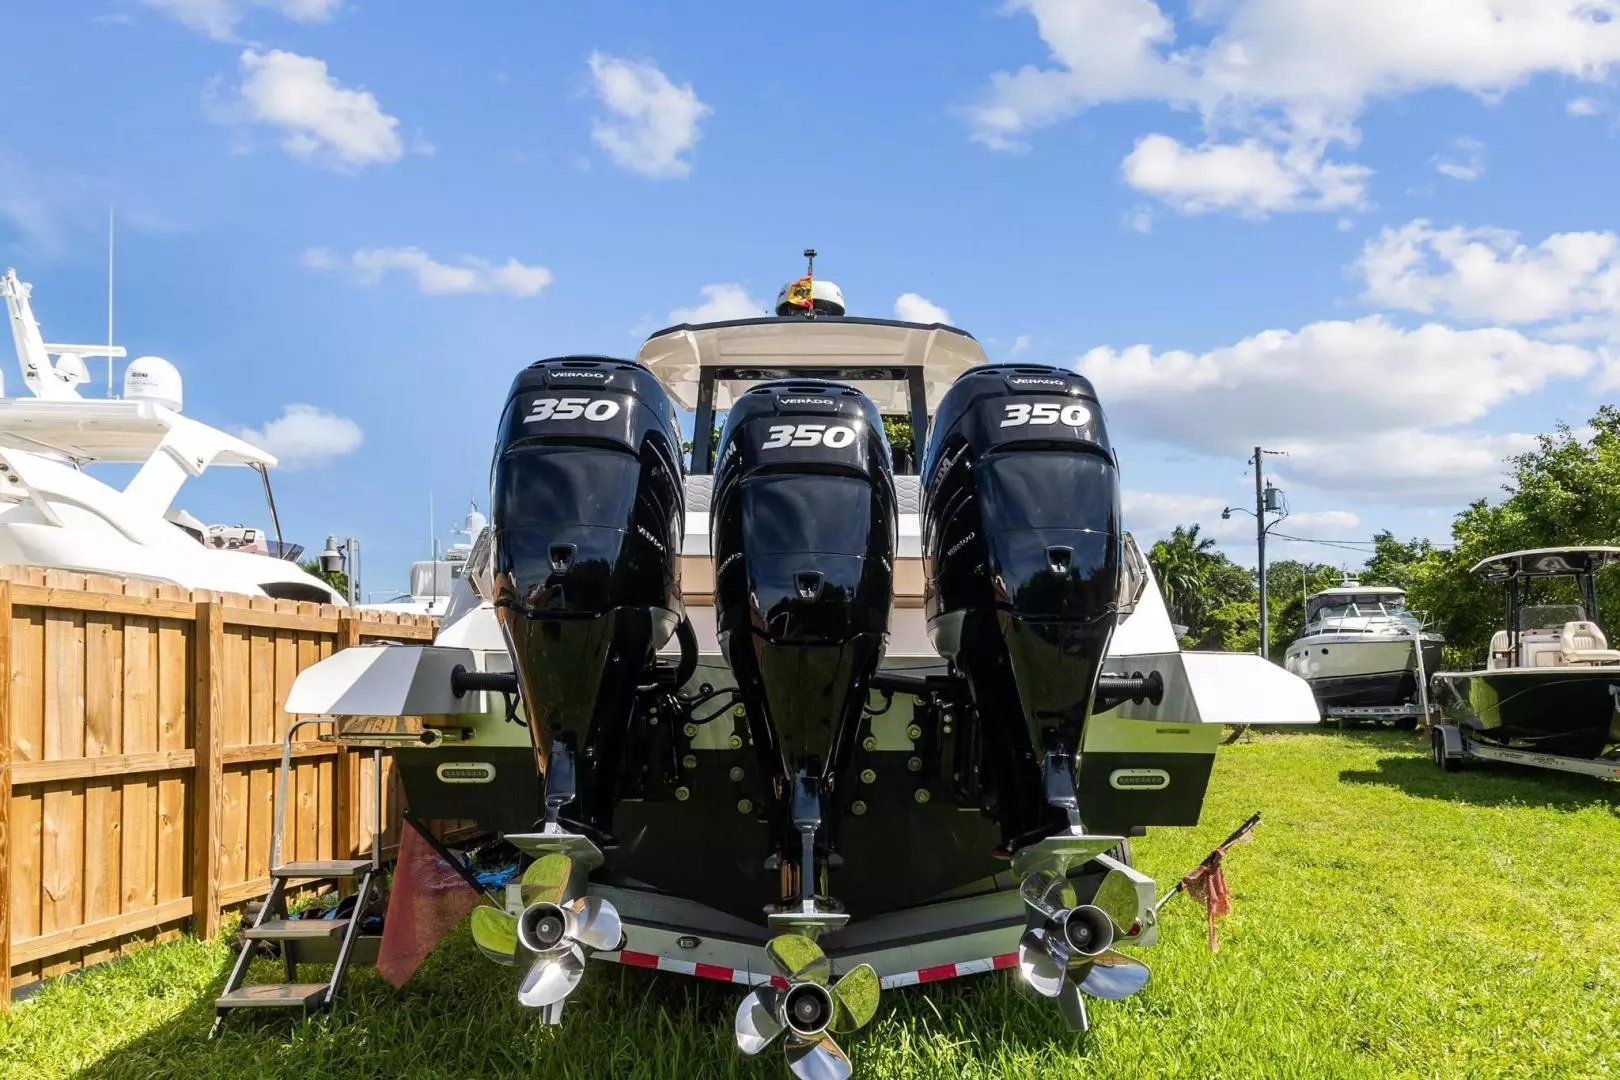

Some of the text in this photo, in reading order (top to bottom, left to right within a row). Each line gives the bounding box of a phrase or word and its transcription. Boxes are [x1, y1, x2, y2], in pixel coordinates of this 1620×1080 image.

[523, 397, 620, 424] 350
[1000, 403, 1091, 428] 350
[761, 424, 855, 450] 350
